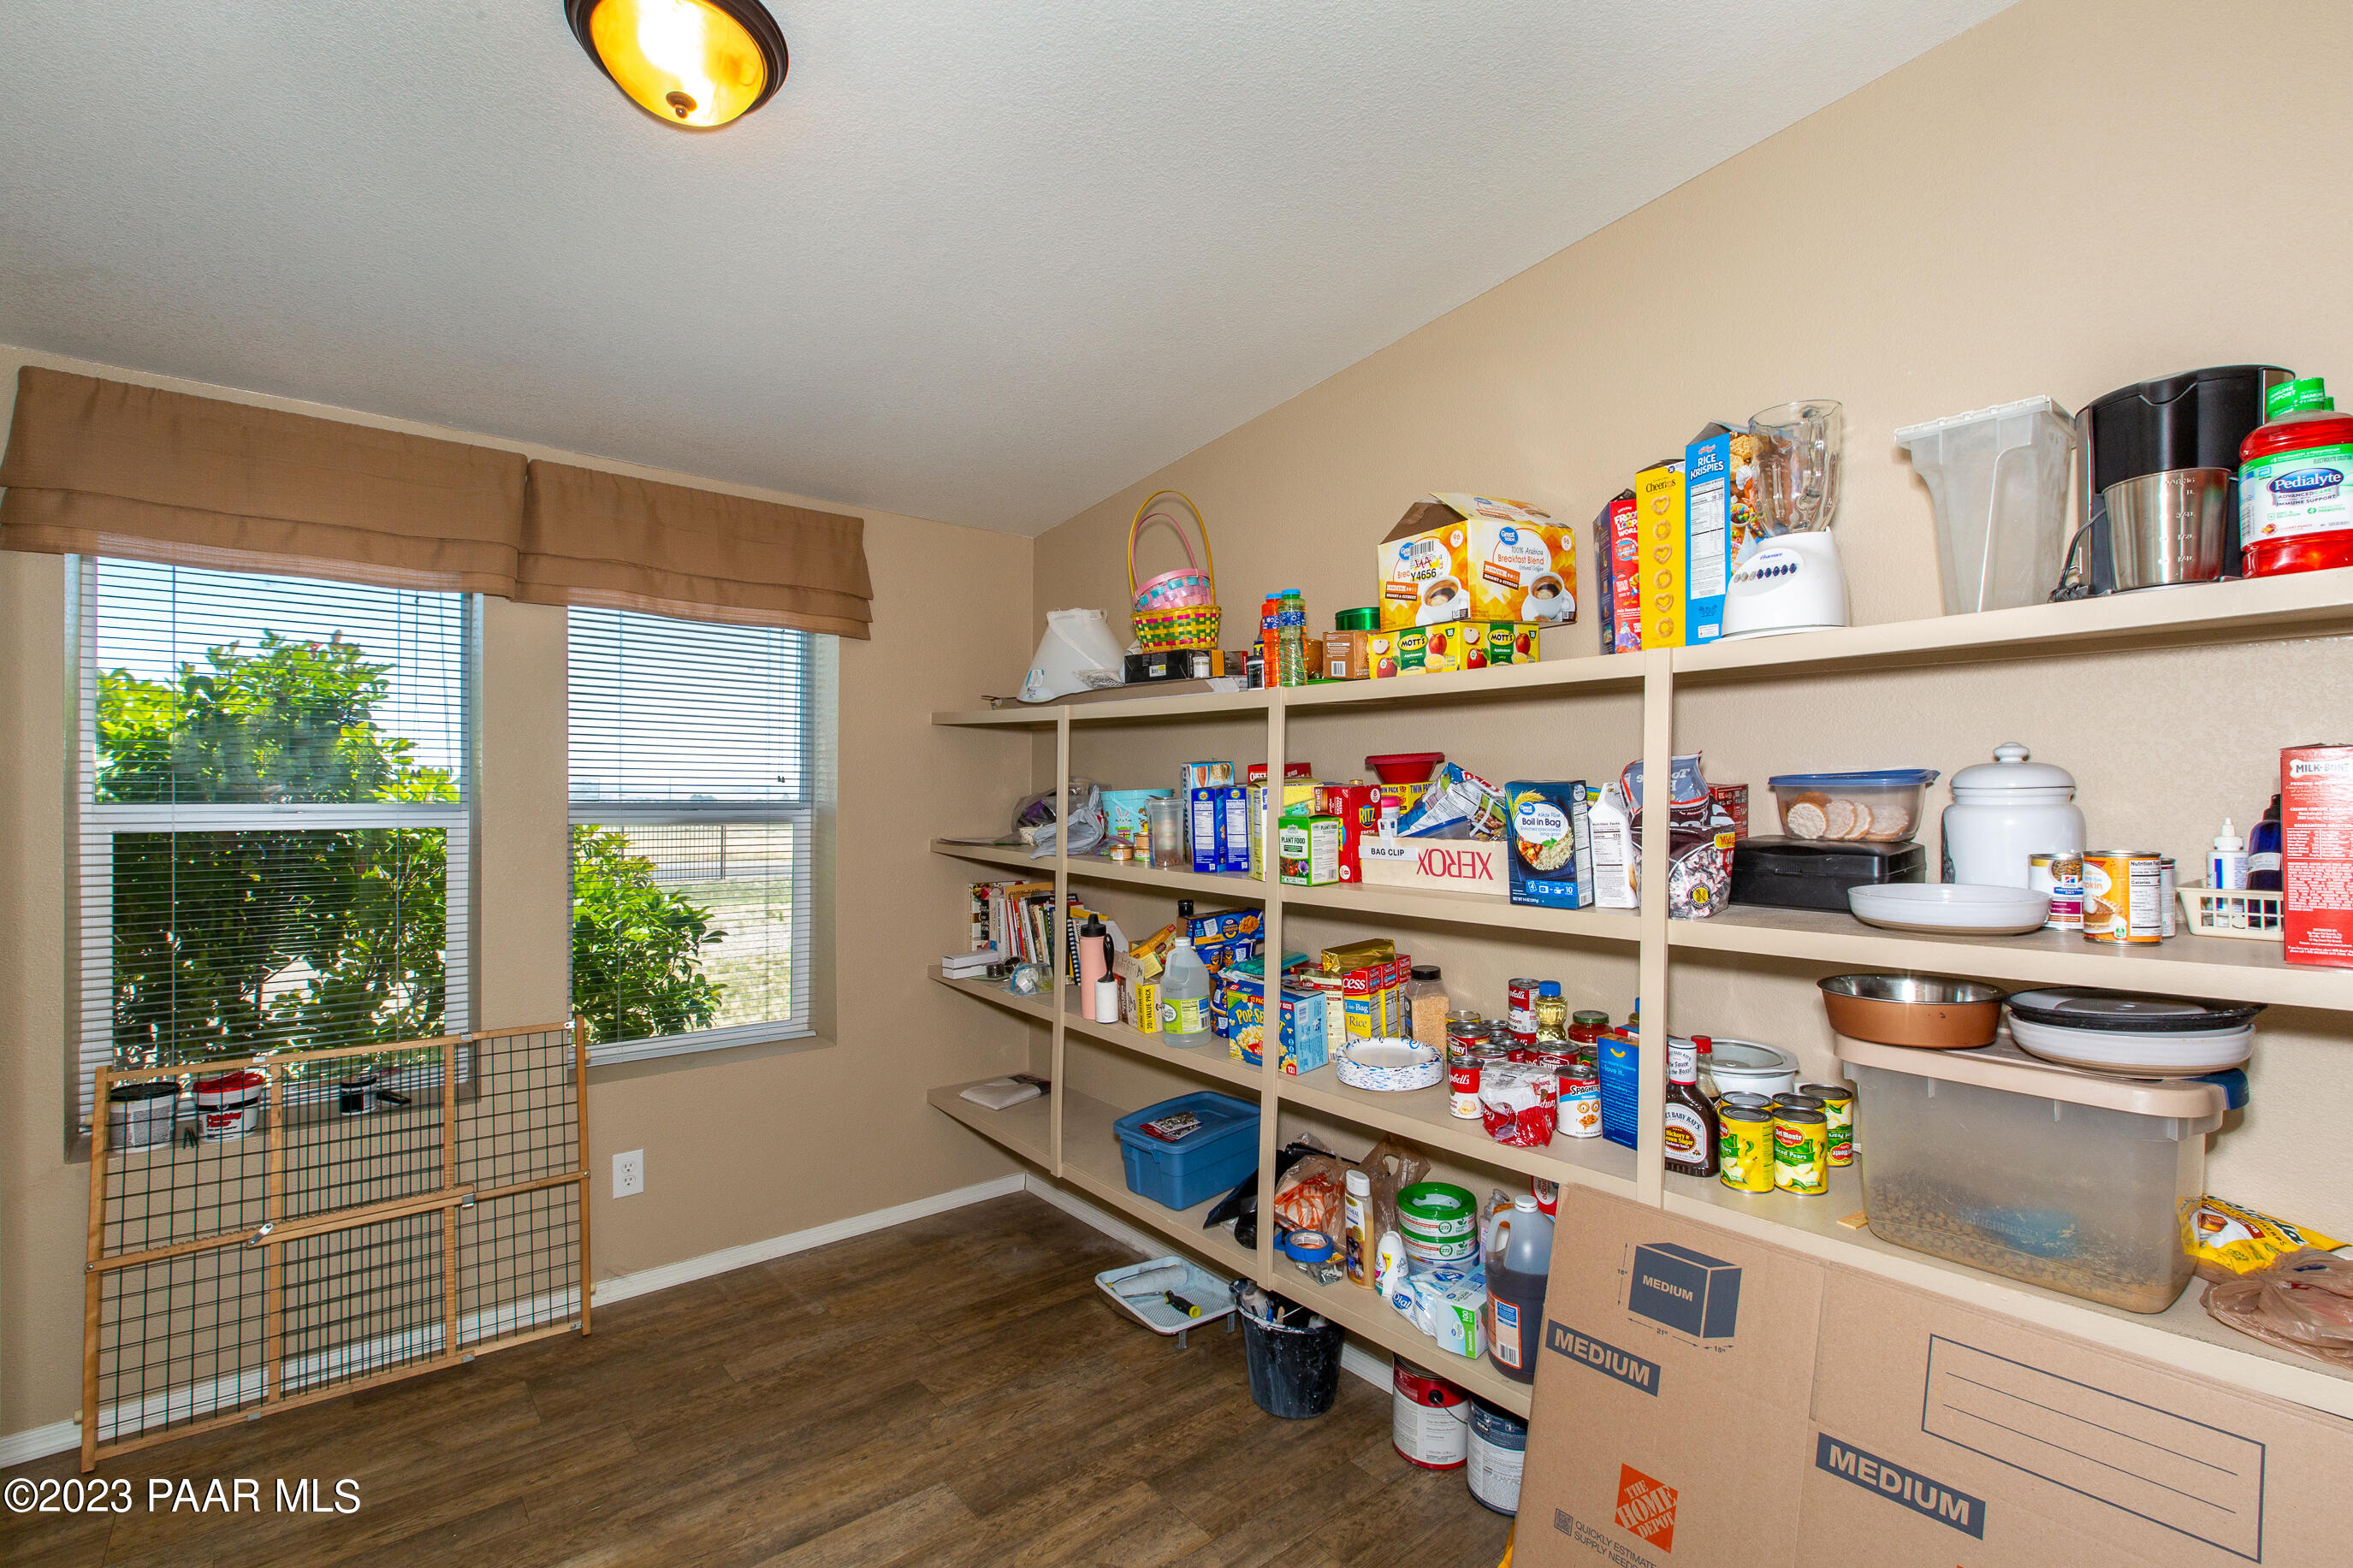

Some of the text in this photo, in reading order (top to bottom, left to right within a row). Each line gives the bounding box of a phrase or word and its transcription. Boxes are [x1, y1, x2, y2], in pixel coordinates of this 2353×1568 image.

[1698, 453, 1716, 466] RICE
[1690, 460, 1724, 481] KRISPIES
[1645, 477, 1676, 494] Cheerios
[2273, 472, 2343, 491] Pedialyte
[2305, 494, 2337, 504] SUPPORT
[1501, 530, 1516, 540] Great
[1525, 547, 1544, 555] Arabica
[1497, 553, 1544, 565] Breakfast Blend
[1410, 568, 1437, 583] Y4656
[1401, 636, 1425, 648] MOTT'S
[1491, 632, 1513, 642] MOTT'S
[1409, 784, 1422, 794] TWIN
[1358, 807, 1377, 824] RITZ
[1544, 819, 1562, 827] Bag
[1281, 836, 1294, 844] PLANT
[1416, 849, 1494, 880] XEROX
[2083, 879, 2103, 891] pkin
[1342, 978, 1366, 991] cess
[1282, 1002, 1293, 1010] SIZE
[1344, 1002, 1369, 1014] l-in-Bag
[1348, 1015, 1367, 1027] Rice
[1604, 1064, 1617, 1075] love
[1449, 1074, 1471, 1086] pbell's
[1671, 1111, 1702, 1131] BABY RAY'S
[1665, 1134, 1693, 1147] rown Sugar
[1783, 1131, 1803, 1141] Monte
[1775, 1145, 1807, 1160] liced Pears
[1642, 1274, 1693, 1303] MEDIUM
[1393, 1292, 1412, 1310] Dial
[1656, 1327, 1668, 1335] 21"
[1555, 1328, 1651, 1388] MEDIUM
[1624, 1479, 1650, 1500] THE
[1828, 1443, 1971, 1526] MEDIUM
[1616, 1485, 1676, 1530] HOME
[1637, 1511, 1674, 1539] DEPOT
[1574, 1531, 1639, 1568] SUPPLY NEEDS
[1575, 1520, 1657, 1568] QUICKLY ESTIMATE
